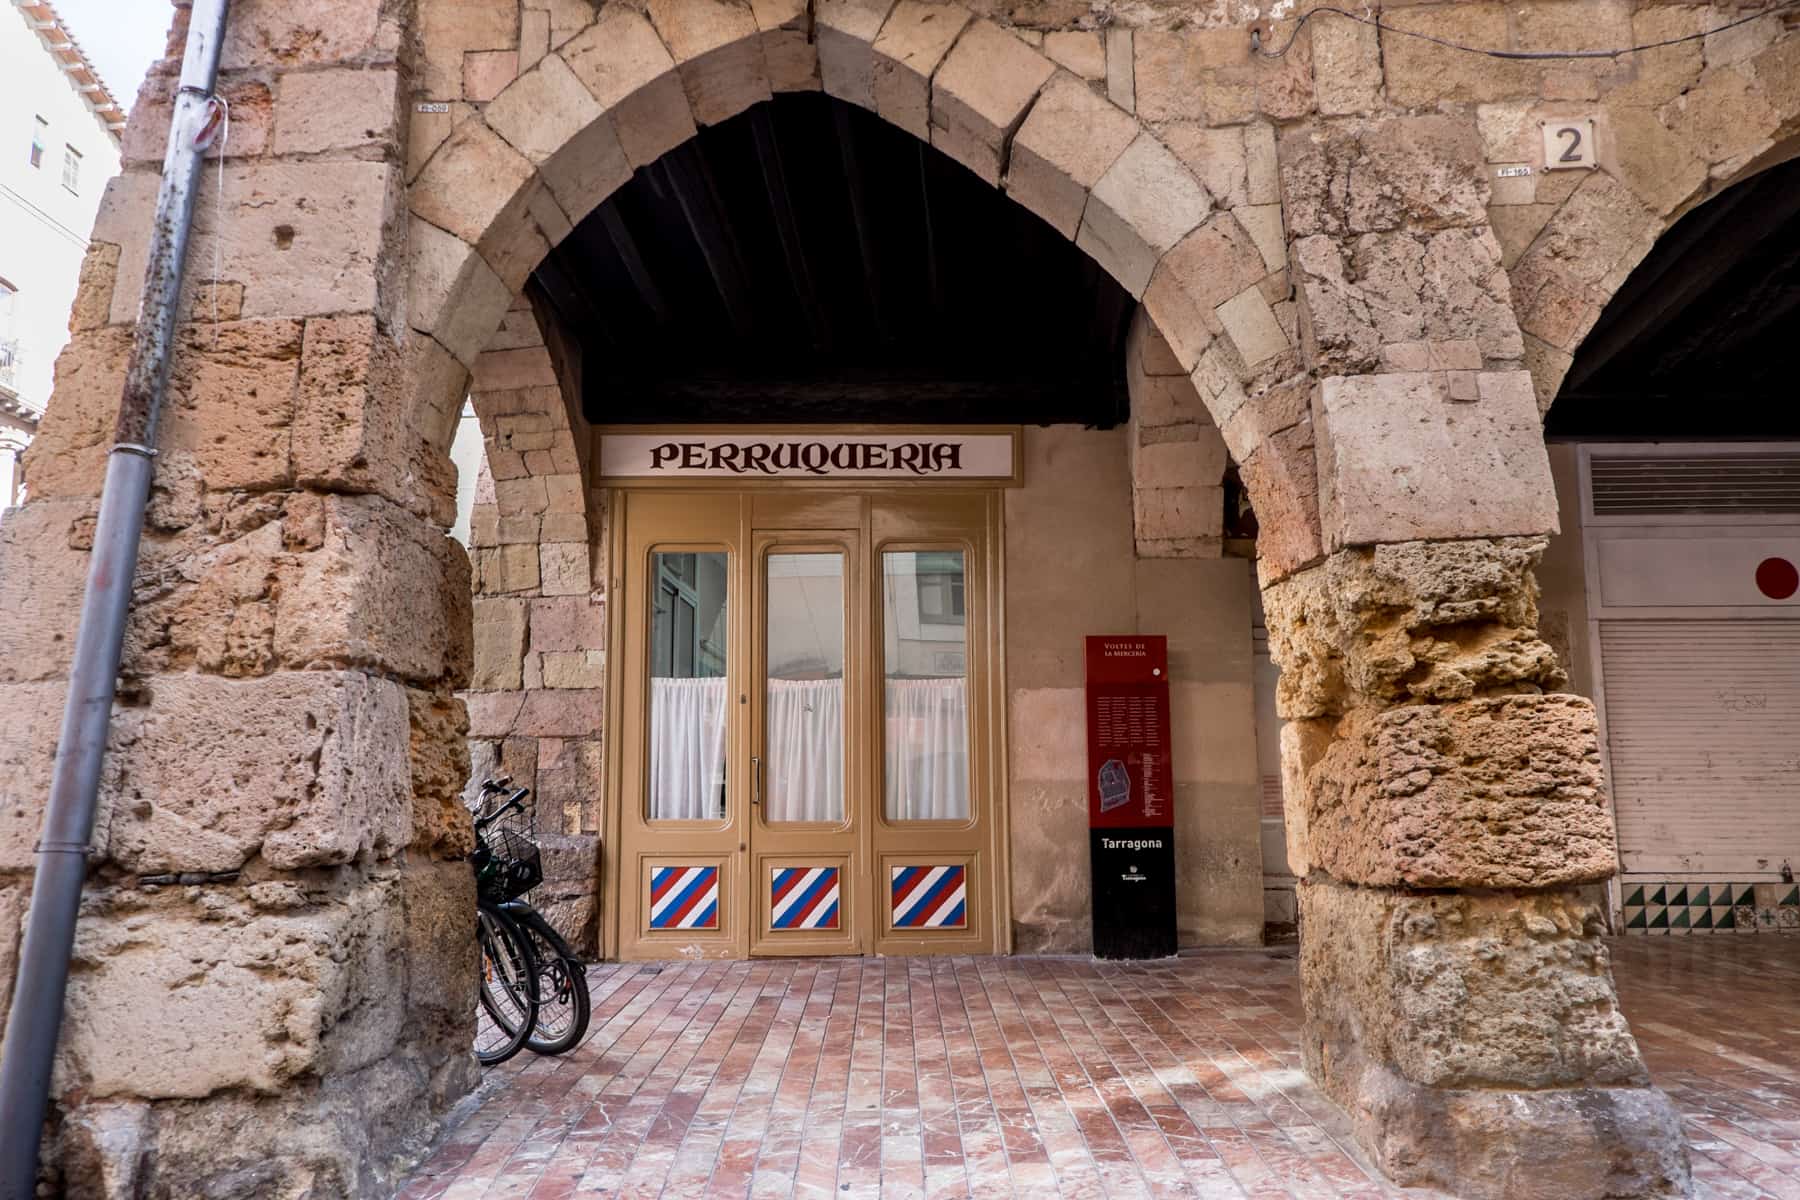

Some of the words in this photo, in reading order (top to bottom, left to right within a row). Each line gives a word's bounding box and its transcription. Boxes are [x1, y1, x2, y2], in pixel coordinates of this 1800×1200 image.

[1556, 127, 1582, 162] 2
[649, 442, 963, 474] PERRUQUERIA
[1101, 838, 1163, 851] Tarragona
